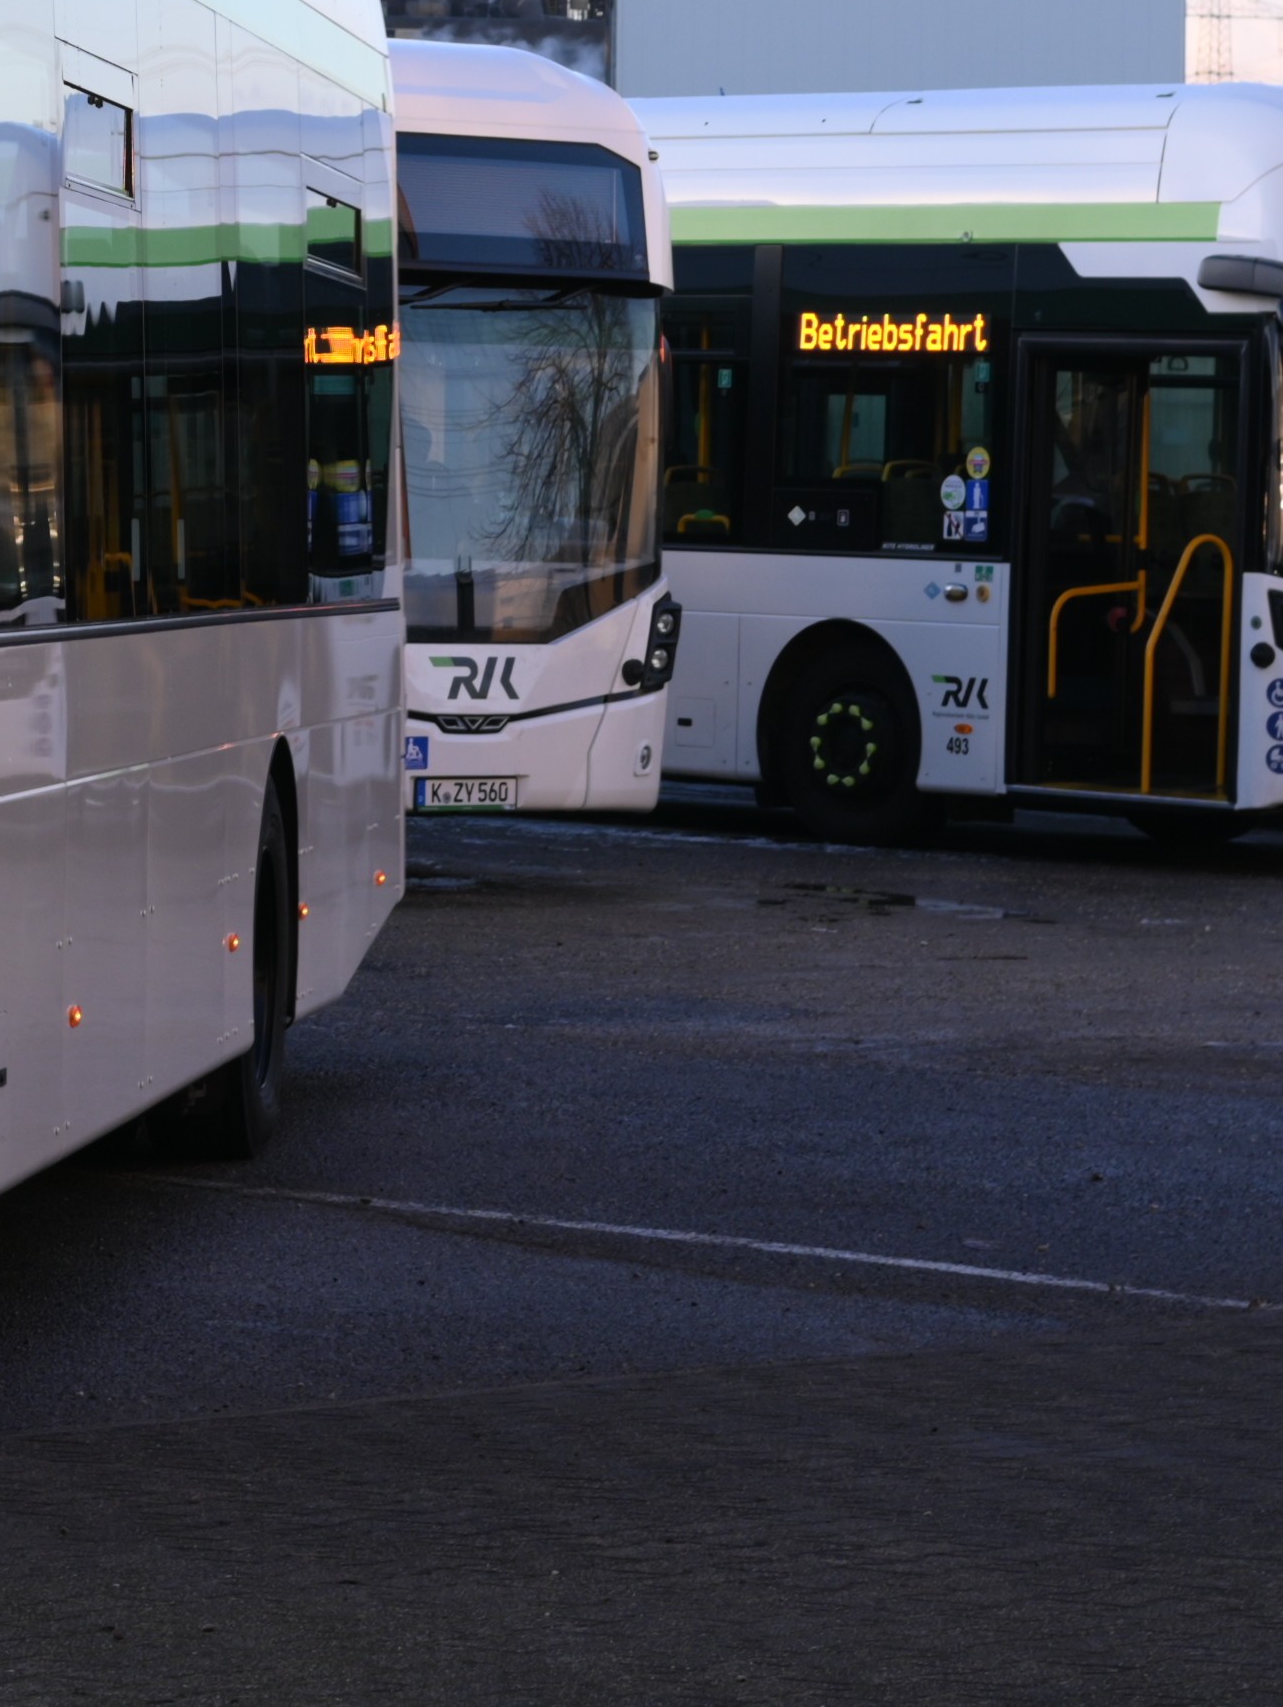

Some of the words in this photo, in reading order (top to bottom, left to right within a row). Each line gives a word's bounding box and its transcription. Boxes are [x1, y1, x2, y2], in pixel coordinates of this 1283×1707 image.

[799, 312, 987, 351] Betriebsfahrt
[428, 656, 520, 700] RVK
[946, 736, 969, 755] 493
[431, 782, 442, 803] K
[453, 782, 475, 803] ZY
[478, 781, 508, 802] 560
